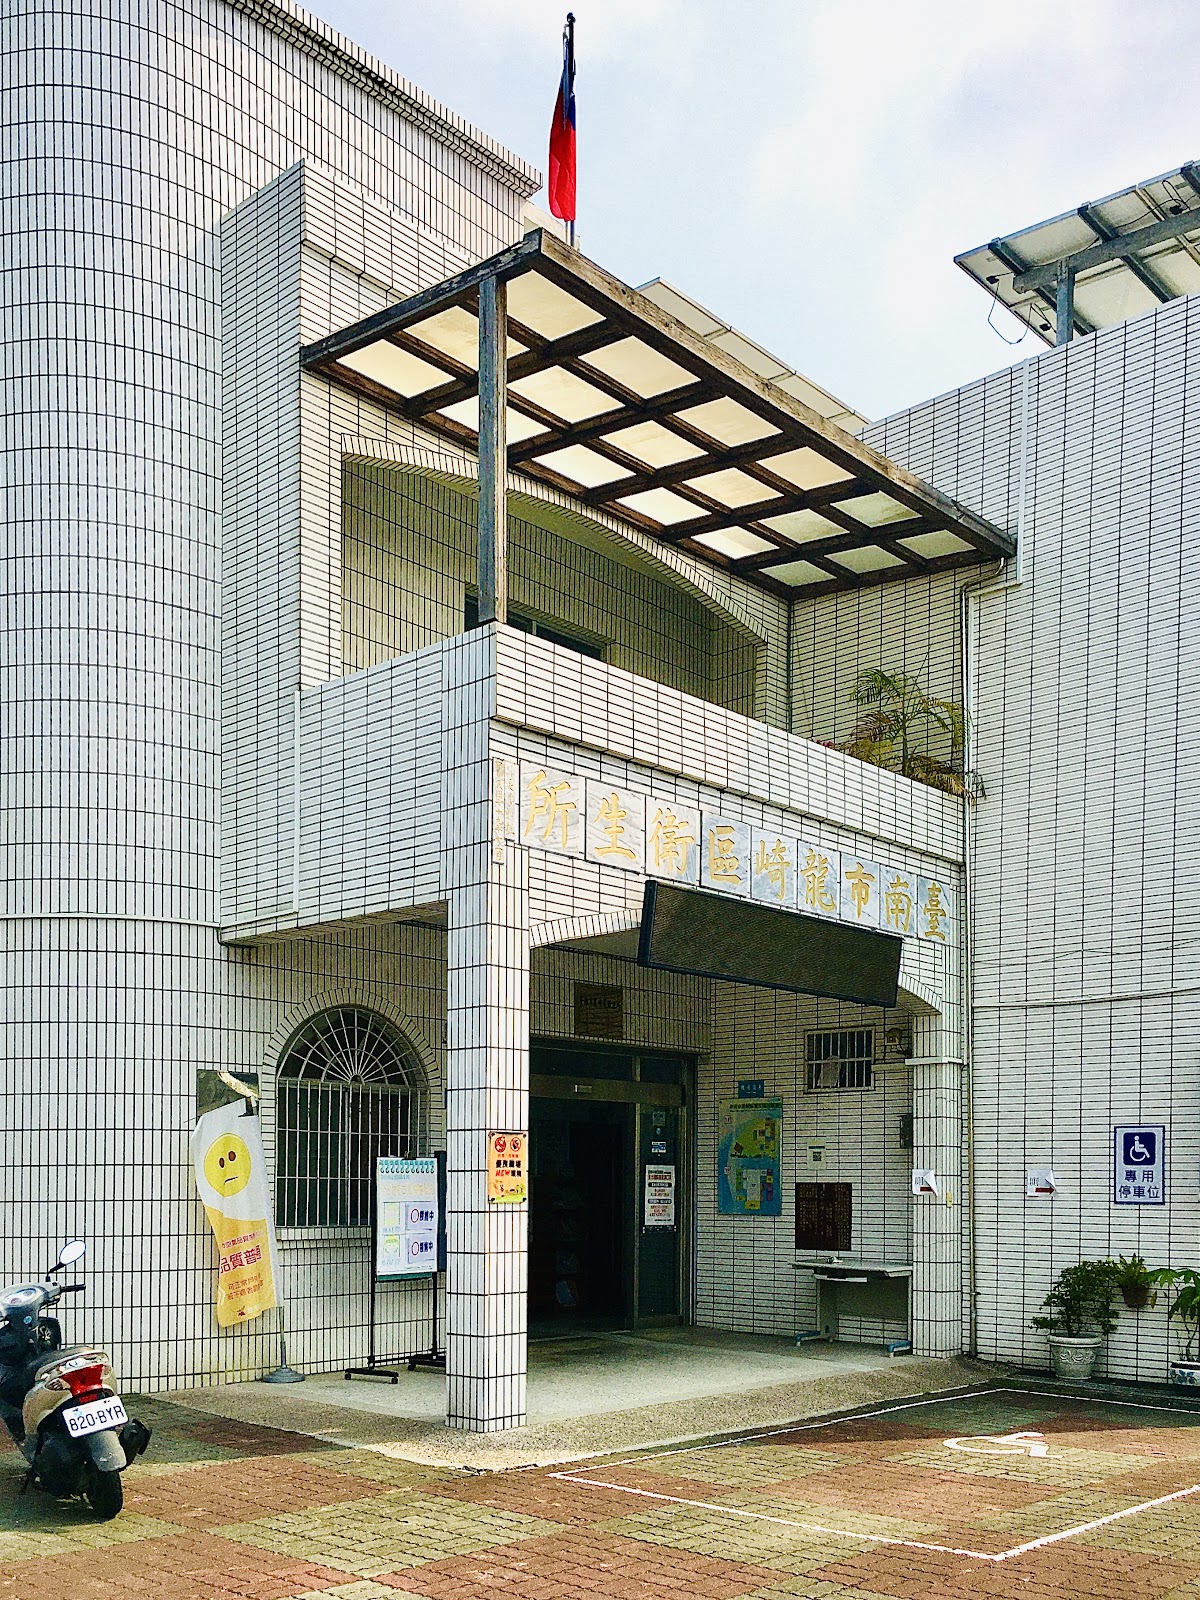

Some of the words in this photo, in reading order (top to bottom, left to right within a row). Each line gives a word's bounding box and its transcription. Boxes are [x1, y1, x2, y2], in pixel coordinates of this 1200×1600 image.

[525, 769, 947, 942] 臺南市龍崎區衛生所
[1124, 1169, 1154, 1183] 專用
[1118, 1185, 1161, 1199] 停車位
